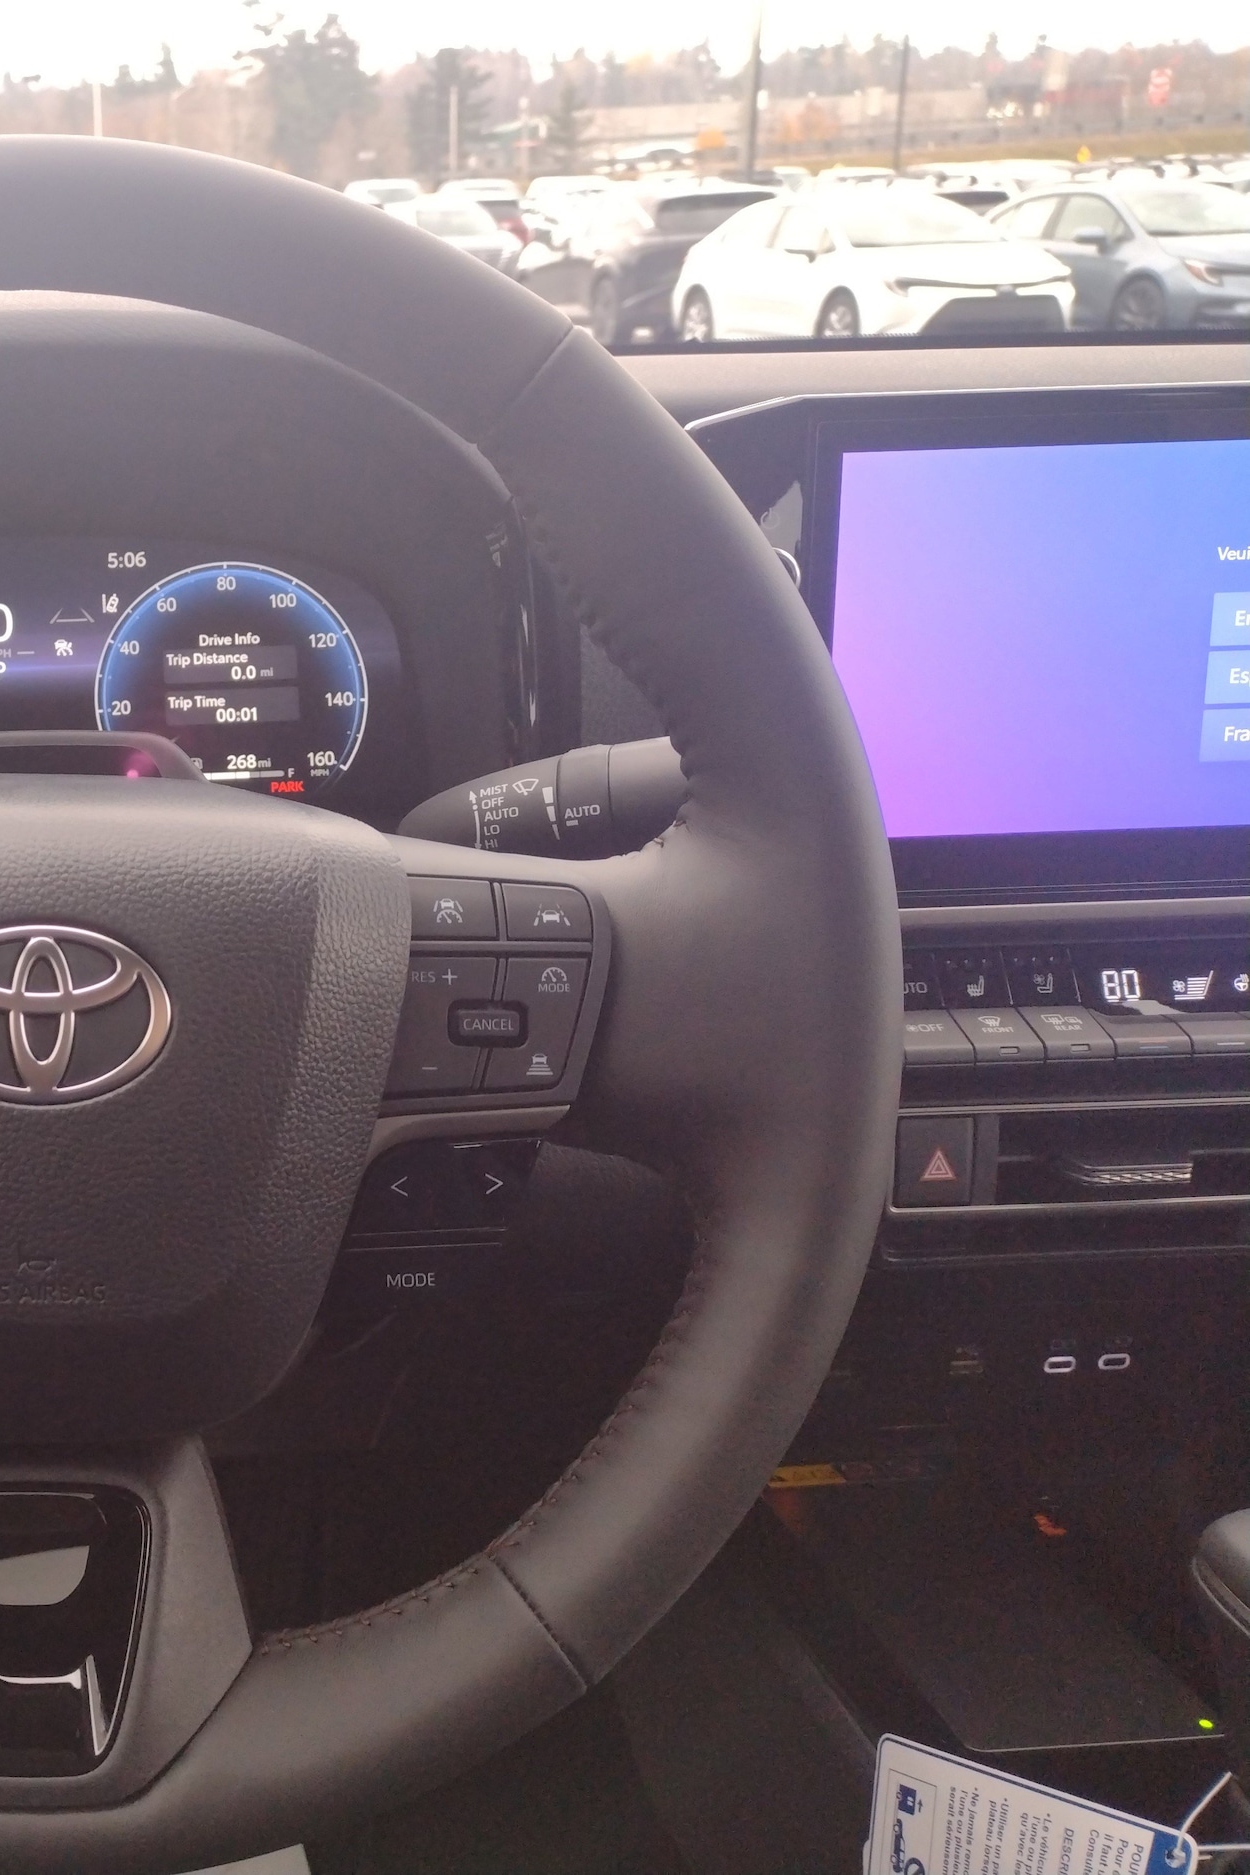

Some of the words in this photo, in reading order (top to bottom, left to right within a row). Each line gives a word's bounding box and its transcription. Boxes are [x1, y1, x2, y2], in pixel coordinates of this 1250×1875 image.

[107, 551, 147, 569] 5:06
[216, 576, 236, 591] 80
[156, 597, 177, 613] 60
[269, 593, 297, 609] 100
[199, 634, 232, 647] Drive
[235, 632, 261, 645] Info
[308, 632, 337, 648] 120
[119, 640, 140, 656] 40
[166, 654, 191, 668] Trip
[193, 652, 248, 666] Distance
[231, 666, 257, 680] 0.0
[260, 667, 274, 677] mi
[1230, 668, 1250, 688] Es
[168, 696, 192, 710] Trip
[194, 695, 226, 708] Time
[325, 692, 354, 707] 140
[111, 701, 131, 716] 20
[215, 707, 258, 723] 00:01
[226, 754, 257, 770] 268
[258, 757, 272, 768] mi
[306, 751, 335, 767] 160
[287, 767, 295, 778] F
[310, 769, 330, 777] MPH
[271, 780, 304, 793] PARK
[479, 783, 509, 798] MIST
[481, 796, 505, 810] OFF
[484, 806, 519, 822] AUTO
[564, 804, 600, 819] AUTO
[483, 824, 500, 836] LO
[484, 839, 498, 850] HI
[411, 970, 436, 984] RES
[1101, 968, 1141, 1000] 80
[538, 982, 570, 993] MODE
[903, 981, 928, 994] UTO
[463, 1018, 514, 1031] CANCEL
[918, 1023, 944, 1032] OFF
[982, 1025, 1014, 1034] FRONT
[1054, 1023, 1082, 1032] REAR
[386, 1272, 436, 1288] MODE
[985, 1799, 998, 1842] plateau
[1099, 1843, 1112, 1867] faut
[1114, 1838, 1129, 1868] Pour
